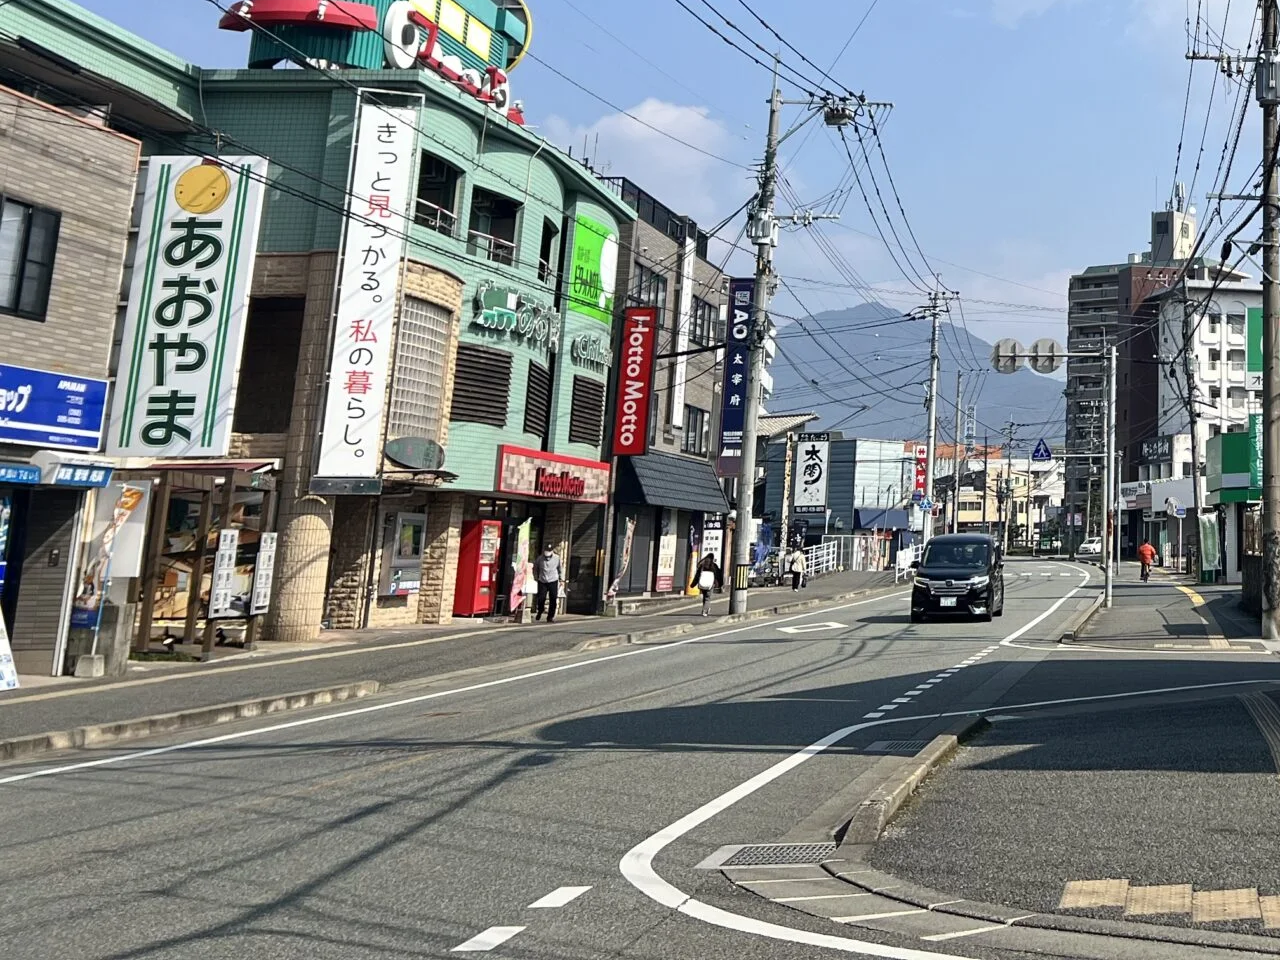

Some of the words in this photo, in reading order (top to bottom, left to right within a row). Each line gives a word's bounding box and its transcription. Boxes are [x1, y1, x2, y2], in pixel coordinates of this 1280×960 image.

[361, 122, 398, 306] きっと見つかる。
[140, 216, 224, 446] あおやま
[342, 318, 377, 460] 私の暮らし。
[729, 353, 743, 406] 太宰府
